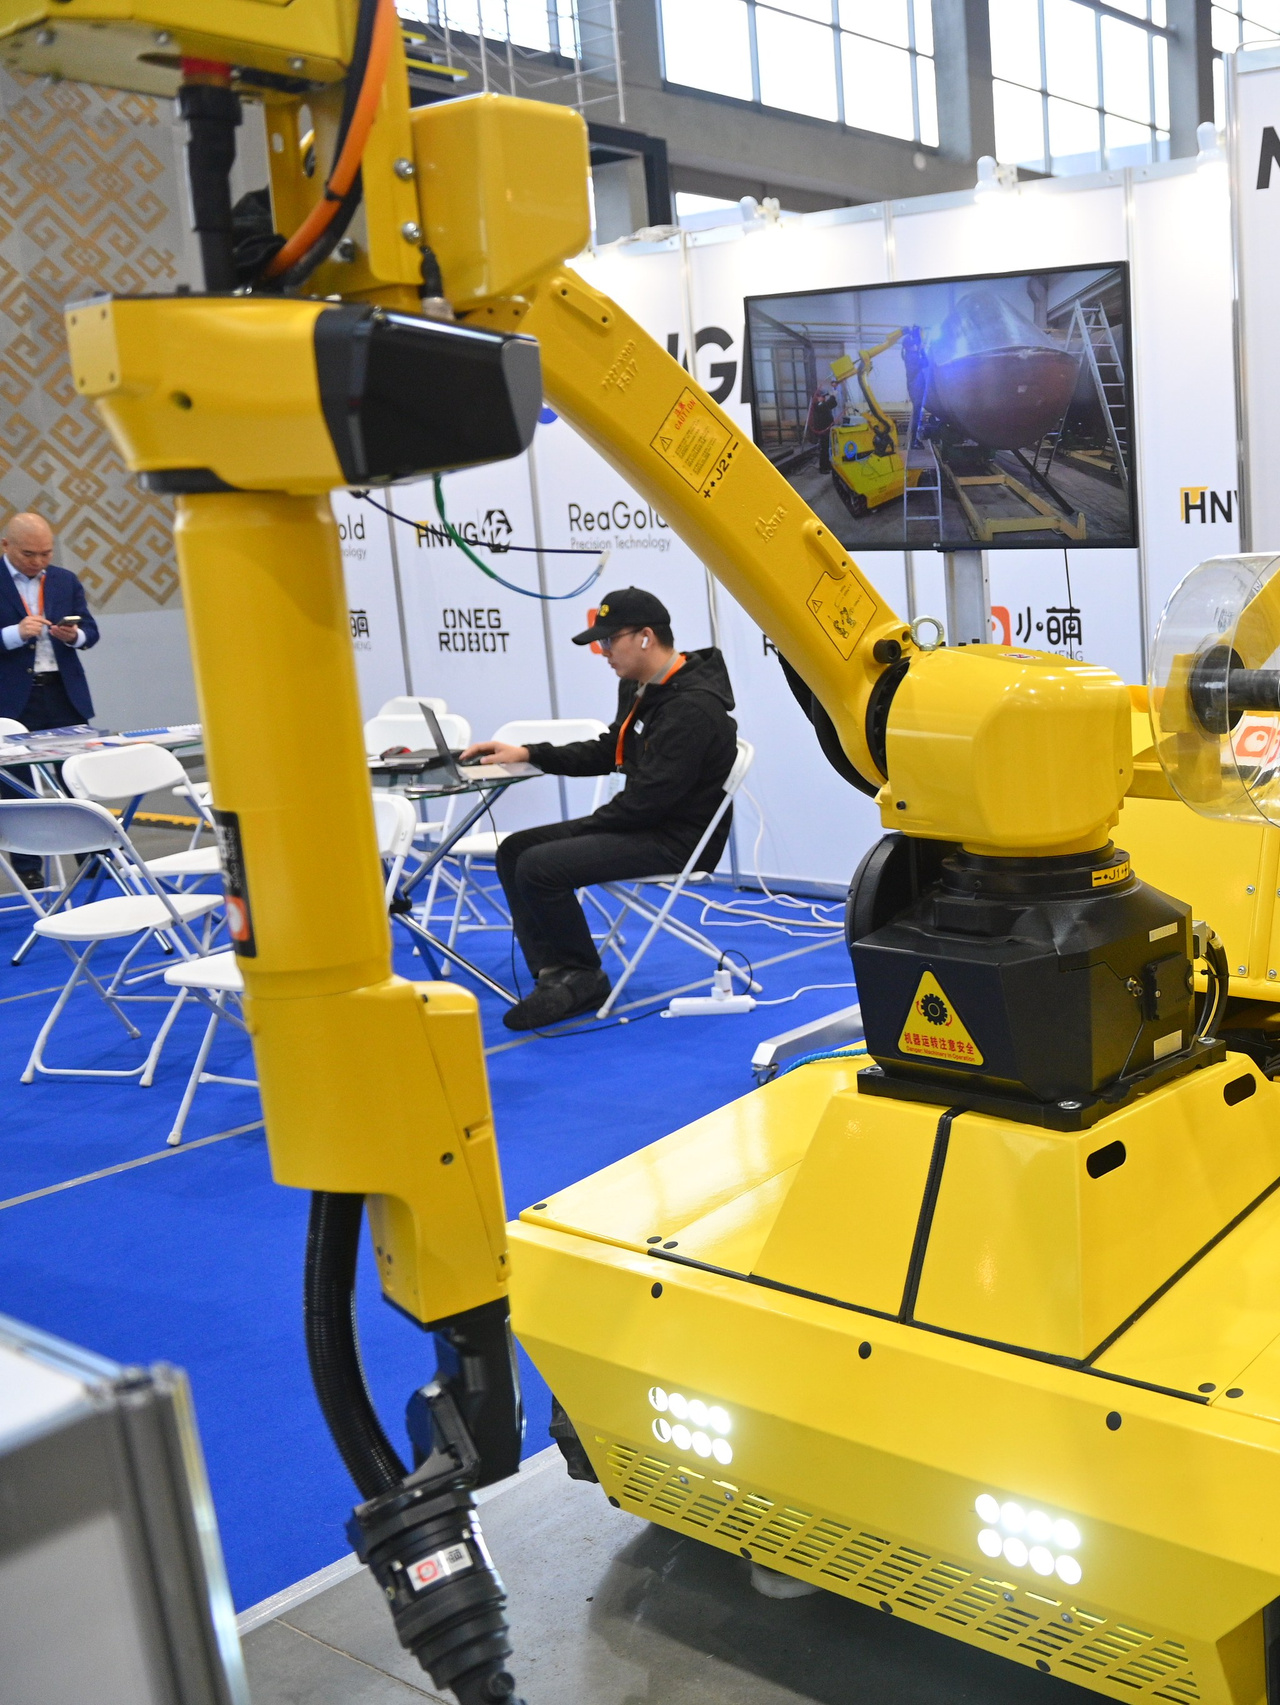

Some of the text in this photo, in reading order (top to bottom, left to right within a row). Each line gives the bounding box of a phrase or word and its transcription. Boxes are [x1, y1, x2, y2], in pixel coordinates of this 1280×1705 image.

[674, 399, 697, 431] CAUTION
[1183, 489, 1238, 524] HN
[570, 534, 671, 552] Precision Technology
[349, 609, 370, 638] 萌
[442, 608, 502, 630] ONEG
[1016, 606, 1082, 645] 小萌
[438, 632, 509, 652] ROBOT
[904, 1032, 975, 1055] 机器运转注意安全
